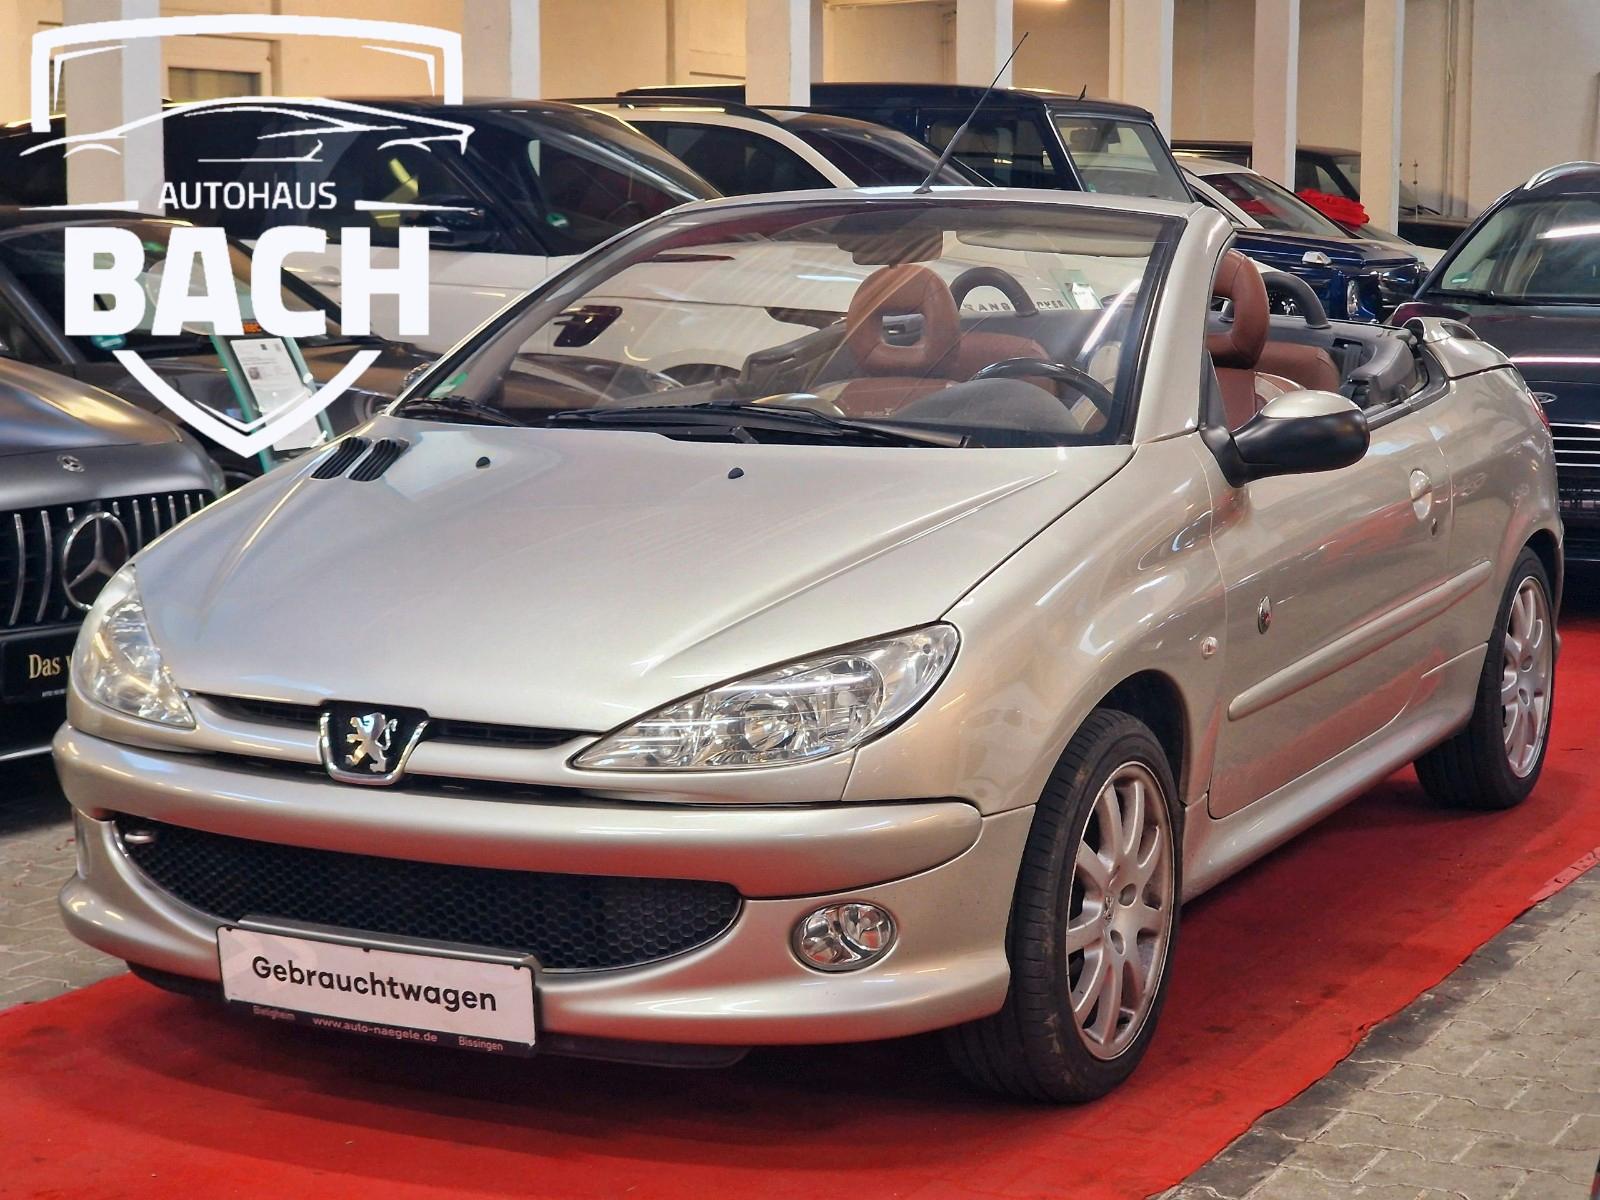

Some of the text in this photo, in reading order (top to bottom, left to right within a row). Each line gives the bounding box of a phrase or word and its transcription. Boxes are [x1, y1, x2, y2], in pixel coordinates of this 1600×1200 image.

[28, 654, 61, 679] Das
[252, 956, 497, 1012] Gebrauchtwagen
[312, 1016, 504, 1052] www.auto-naegele.de Bissingen
